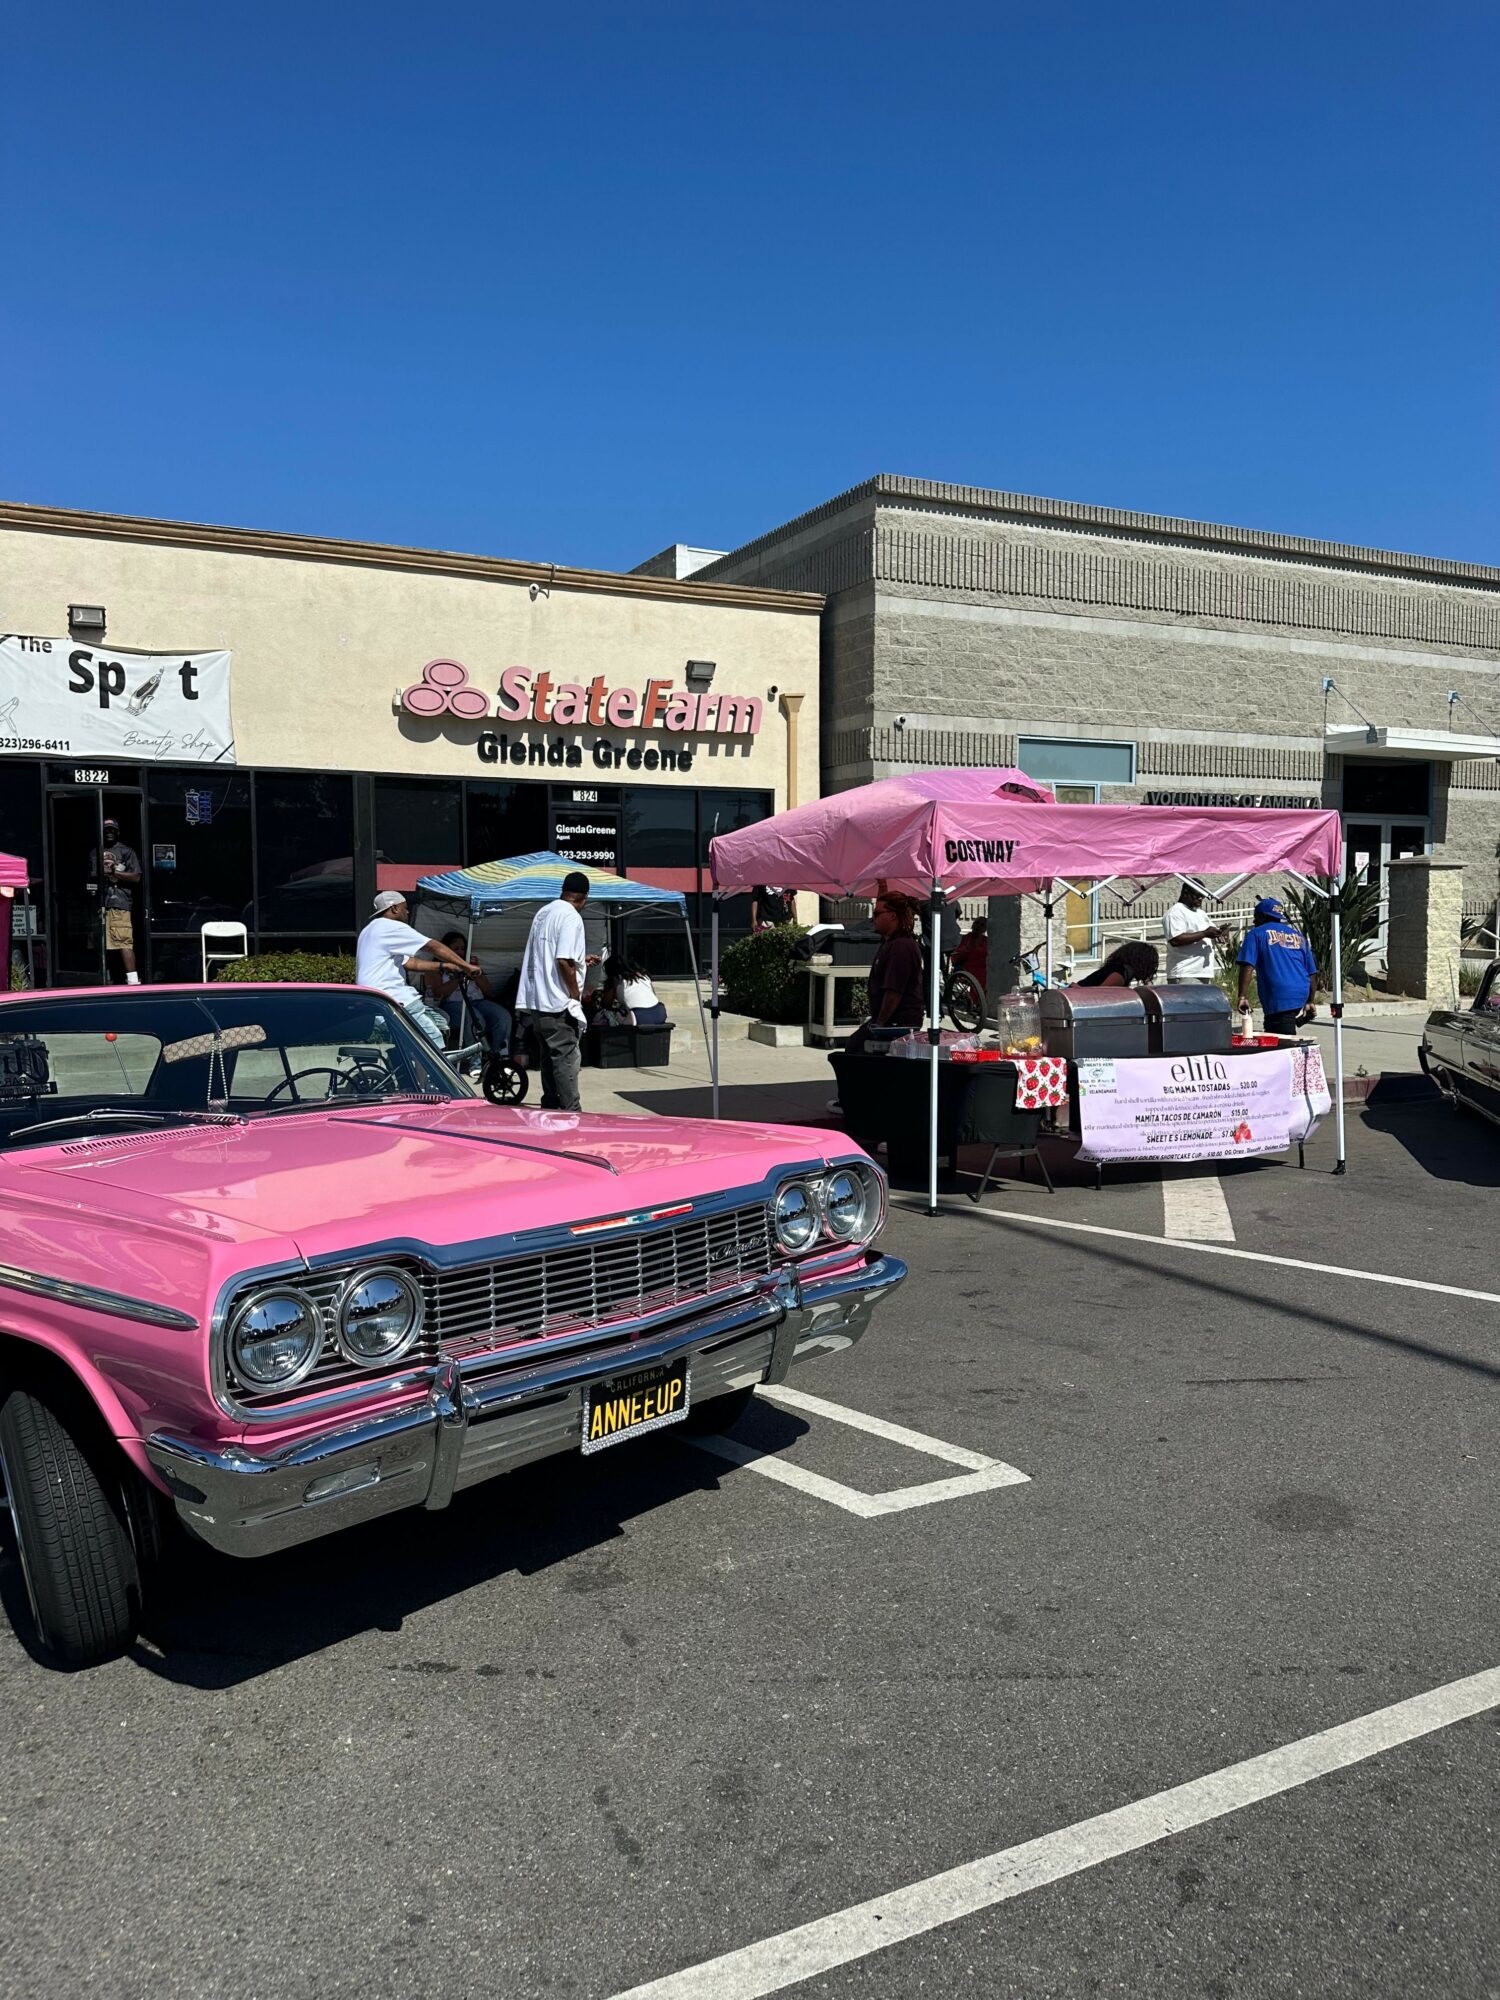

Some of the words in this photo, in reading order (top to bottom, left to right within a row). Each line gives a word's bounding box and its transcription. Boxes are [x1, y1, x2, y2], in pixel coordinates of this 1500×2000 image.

[18, 636, 52, 653] The
[123, 730, 175, 759] Beauty
[181, 728, 217, 759] Shop
[477, 733, 582, 767] Glenda
[592, 739, 692, 771] Greene
[76, 769, 108, 782] 3822
[1151, 792, 1240, 808] VOLUNTEERS
[1242, 794, 1262, 809] OF
[1264, 796, 1321, 809] AMERICA
[558, 850, 615, 860] 323-293-9990
[1163, 1086, 1174, 1094] BIG
[1175, 1085, 1196, 1093] MAMA
[1198, 1083, 1231, 1092] TOSTADAS
[1135, 1114, 1160, 1123] MAMITA
[1161, 1113, 1182, 1122] TACOS
[1183, 1112, 1191, 1120] DE
[1180, 1131, 1213, 1141] LEMONADE
[590, 1378, 682, 1440] ANNEEUP
